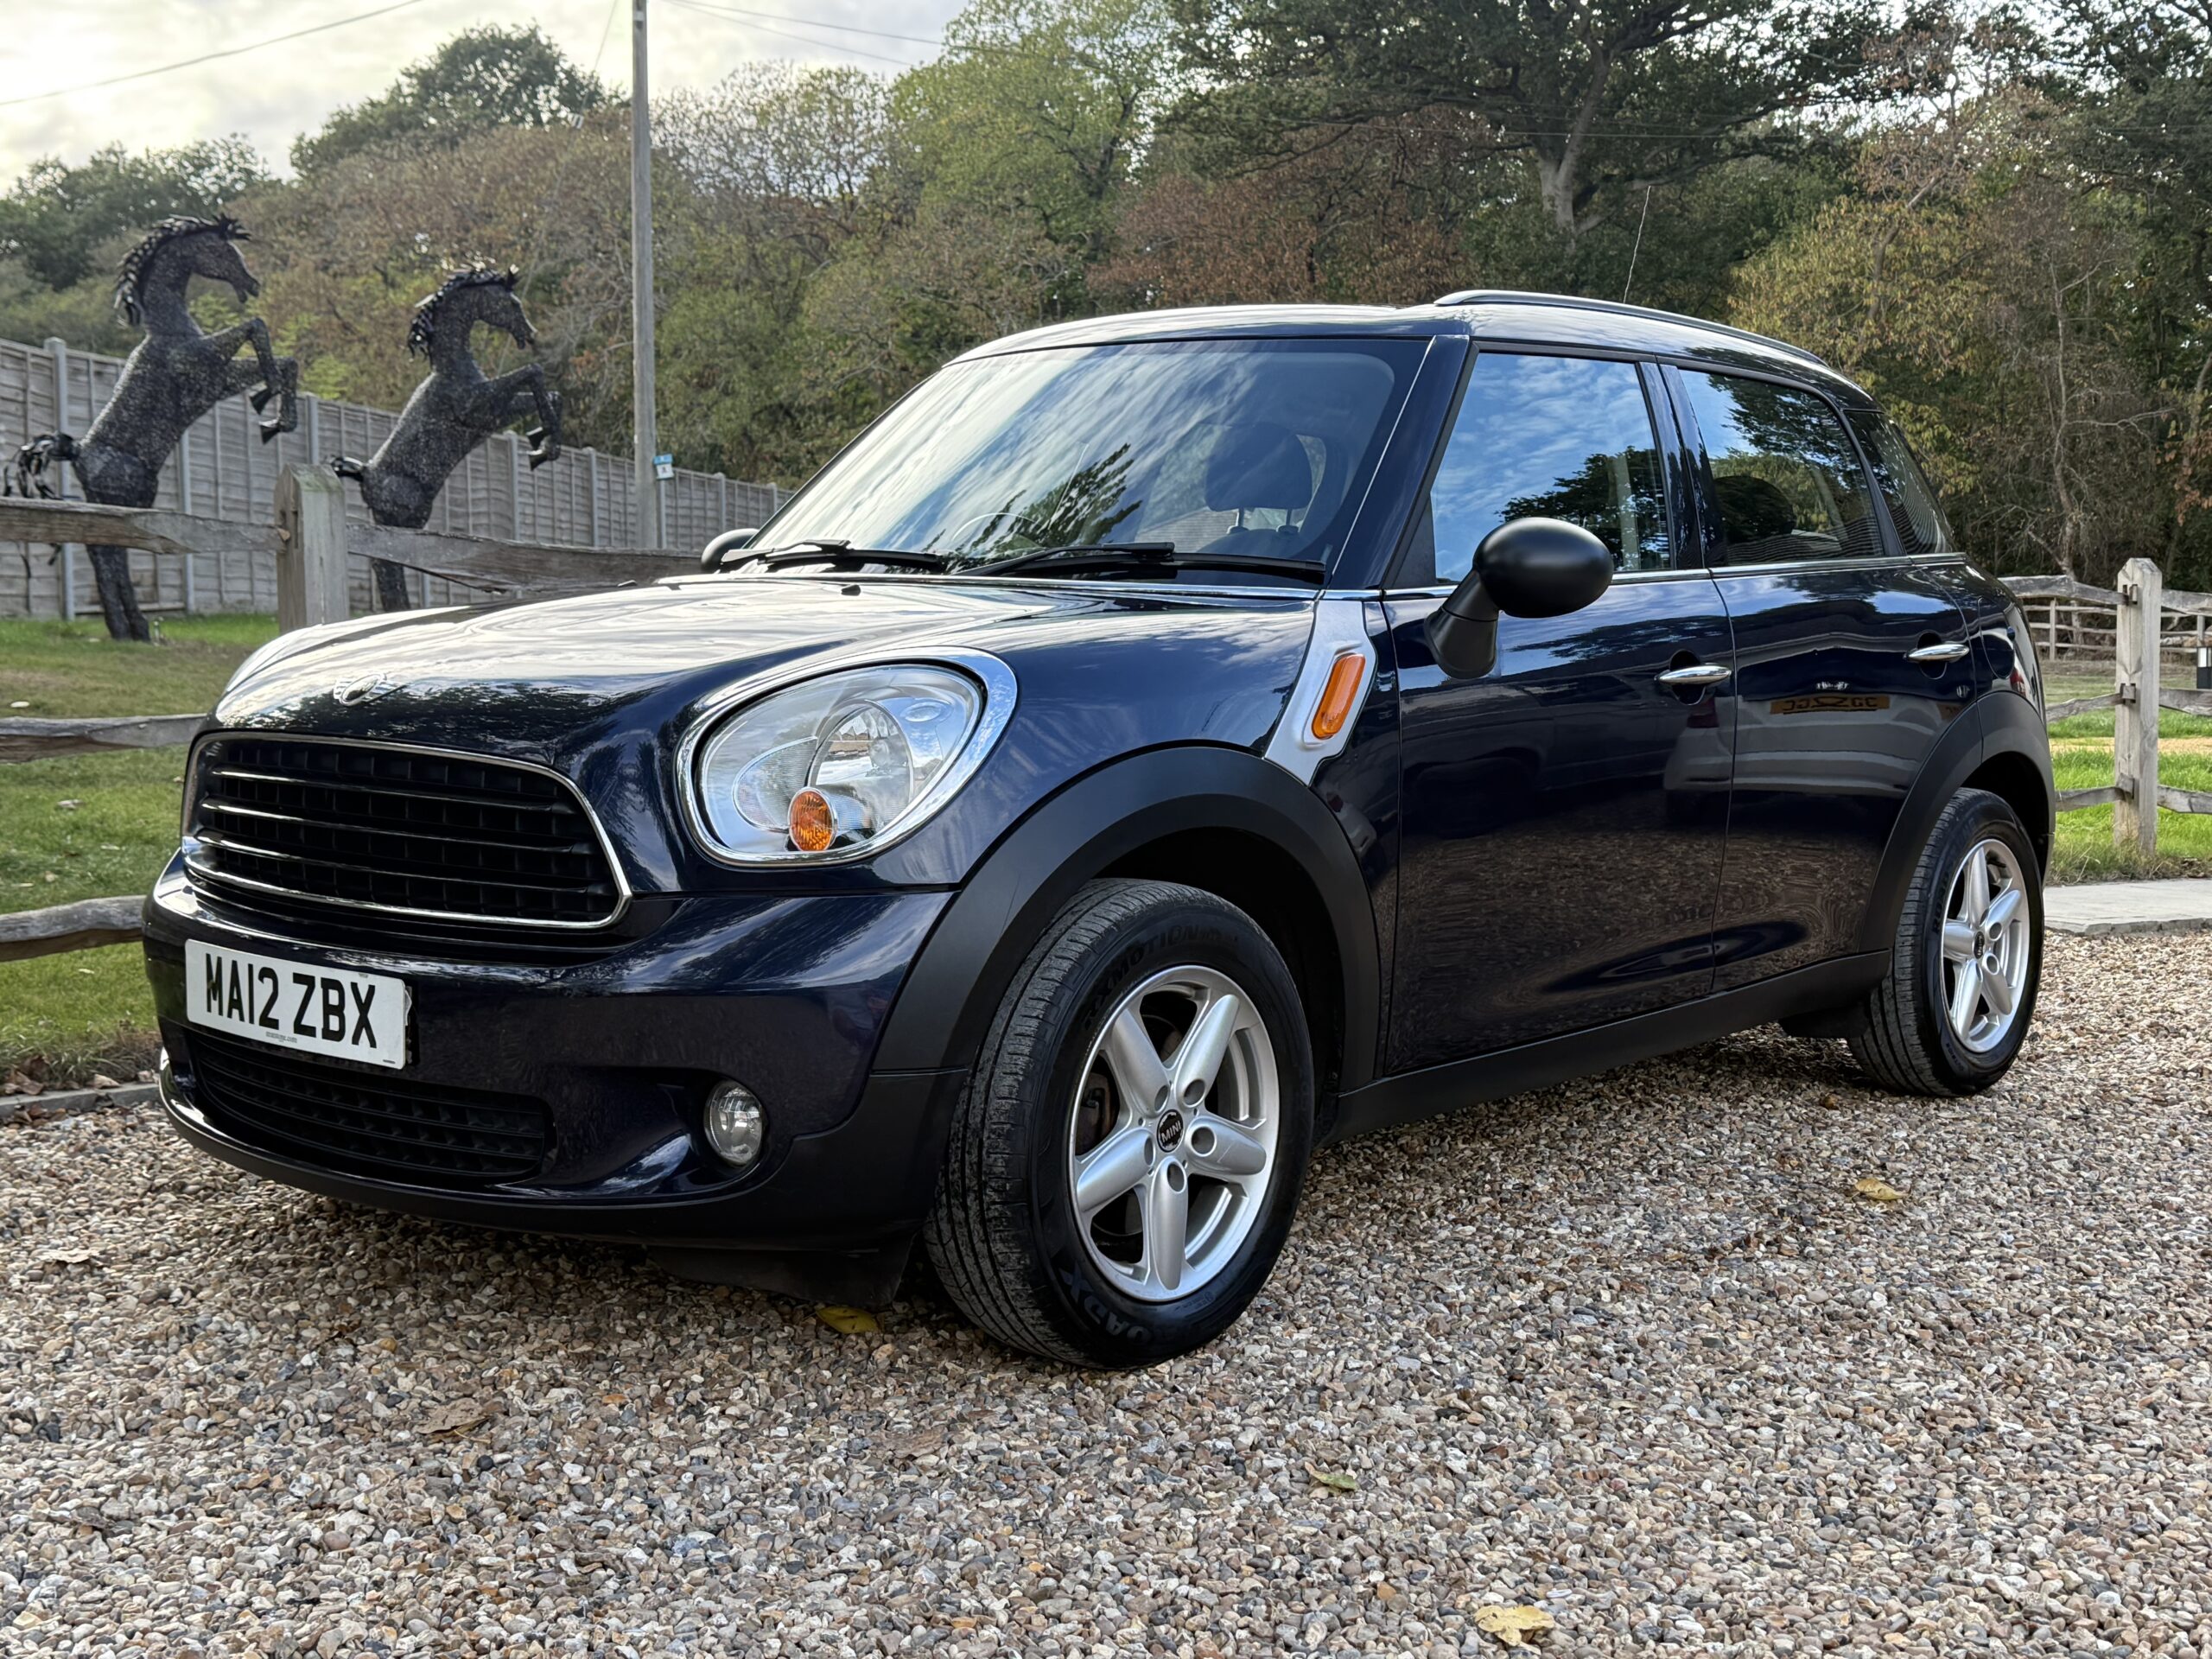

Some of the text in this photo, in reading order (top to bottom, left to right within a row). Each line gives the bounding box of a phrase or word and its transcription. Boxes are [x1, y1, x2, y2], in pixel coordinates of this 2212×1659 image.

[205, 952, 378, 1049] MA12 ZBX
[1160, 1120, 1182, 1143] MINI
[1058, 1259, 1163, 1345] OADX
